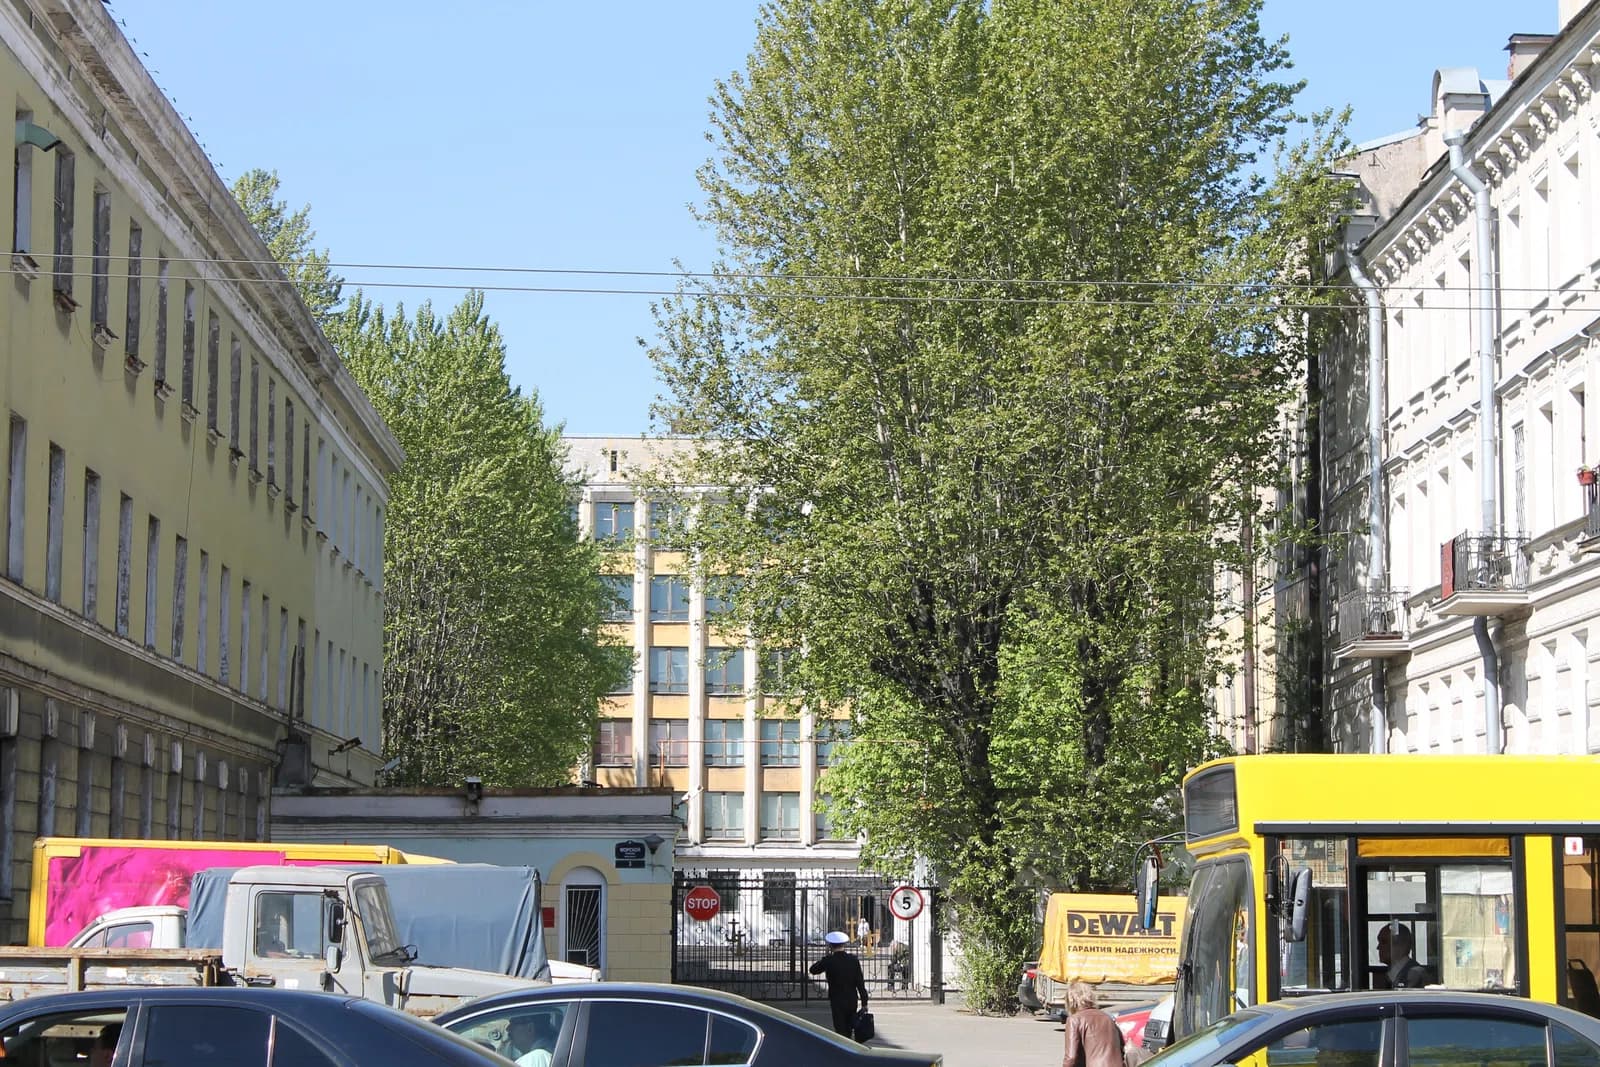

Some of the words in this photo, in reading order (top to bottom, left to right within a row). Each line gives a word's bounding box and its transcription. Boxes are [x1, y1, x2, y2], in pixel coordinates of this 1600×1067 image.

[688, 898, 718, 909] STOP
[902, 896, 912, 910] 5
[1068, 945, 1112, 953] ГАРАНТИЯ
